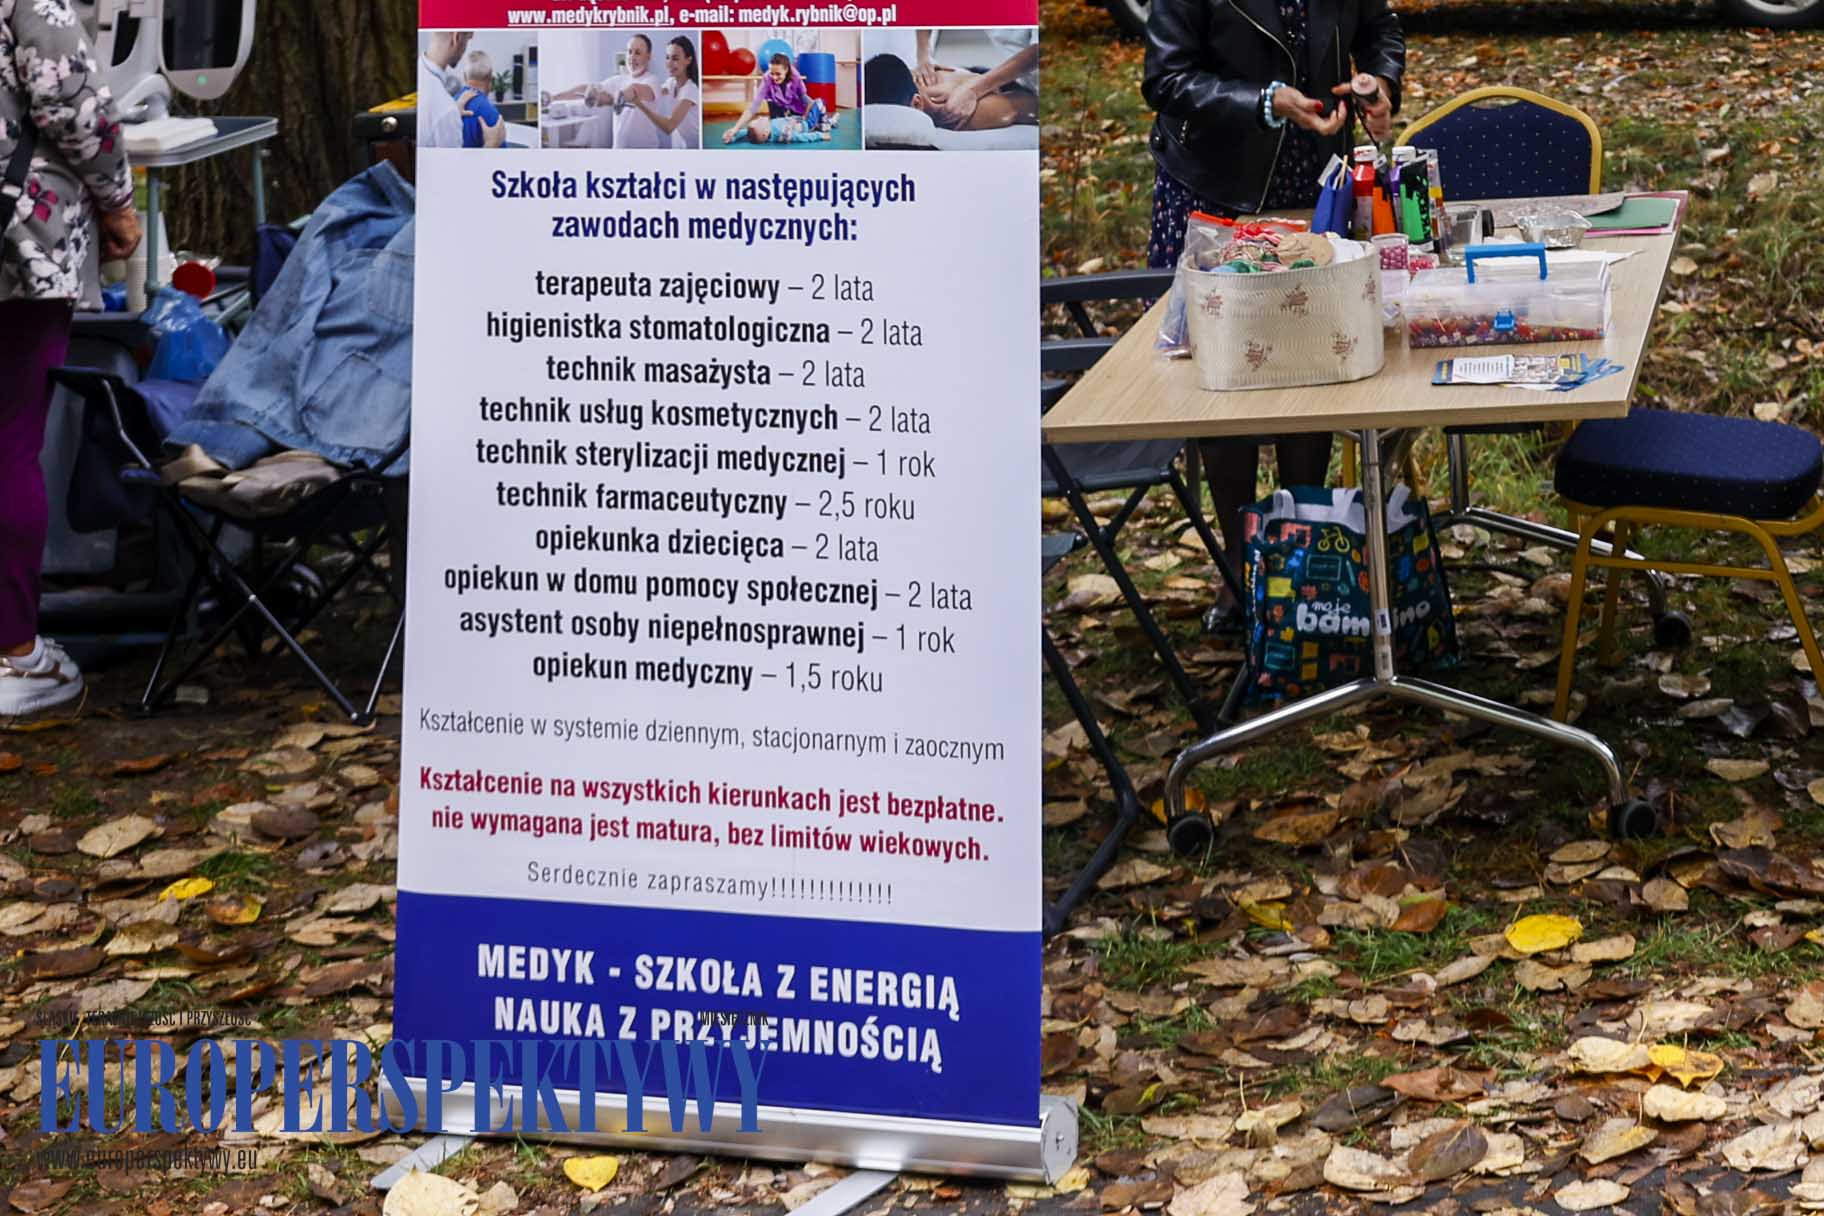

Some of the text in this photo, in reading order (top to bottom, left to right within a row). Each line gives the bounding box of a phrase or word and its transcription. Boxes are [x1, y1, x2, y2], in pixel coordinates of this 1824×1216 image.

[507, 4, 897, 27] www.medykrybnik.pl, e-mail: medyk.rybnik@op.pl
[492, 170, 914, 208] Szkoła kształci w następujących
[553, 211, 856, 246] zawodach medycznych:
[536, 271, 651, 301] terapeuta
[660, 272, 779, 304] zajęciowy
[812, 274, 824, 299] 2
[835, 274, 873, 301] lata
[488, 312, 621, 343] higienistka
[630, 315, 829, 347] stomatologiczna
[861, 318, 873, 344] 2
[884, 319, 922, 346] lata
[546, 356, 635, 381] technik
[645, 358, 770, 389] masażysta
[803, 360, 815, 386] 2
[826, 360, 864, 387] lata
[480, 397, 570, 422] technik
[580, 399, 642, 430] usług
[652, 400, 837, 434] kosmetycznych
[869, 405, 881, 431] 2
[892, 406, 930, 433] lata
[476, 439, 567, 464] technik
[576, 442, 707, 475] sterylizacji
[718, 445, 844, 479] medycznej
[878, 449, 885, 475] 1
[900, 451, 935, 477] rok
[497, 482, 587, 508] technik
[596, 483, 787, 520] farmaceutyczny
[820, 490, 854, 520] 2,5
[866, 493, 914, 520] roku
[536, 525, 659, 555] opiekunka
[669, 528, 783, 563] dziecięca
[816, 533, 828, 559] 2
[840, 534, 878, 561] lata
[445, 564, 538, 595] opiekun
[547, 573, 565, 591] w
[575, 568, 636, 594] domu
[647, 577, 738, 604] pomocy
[748, 576, 877, 611] społecznej
[909, 581, 921, 607] 2
[932, 582, 972, 610] lata
[1312, 598, 1351, 616] moje
[460, 609, 562, 637] asystent
[572, 612, 639, 643] osoby
[649, 614, 863, 653] niepełnosprawnej
[897, 624, 904, 650] 1
[919, 626, 955, 653] rok
[533, 652, 627, 682] opiekun
[635, 657, 753, 691] medyczny
[786, 662, 821, 691] 1,5
[832, 665, 882, 692] roku
[421, 708, 523, 735] Kształcenie
[531, 719, 546, 735] w
[554, 717, 638, 741] systemie
[646, 720, 744, 749] dziennym,
[753, 727, 885, 757] stacjonarnym
[906, 738, 1003, 764] zaocznym
[421, 767, 1003, 823] Kształcenie na wszystkich kierunkach jest bezpłatne.
[433, 806, 988, 863] nie wymagana jest matura, bez limitów wiekowych.
[528, 861, 637, 888] Serdecznie
[479, 944, 594, 984] MEDYK
[635, 954, 762, 996] SZKOŁA
[777, 965, 795, 998] Z
[811, 967, 959, 1022] ENERGIĄ
[495, 997, 942, 1073] NAUKA Z PRZYJEMNOŚCIĄ
